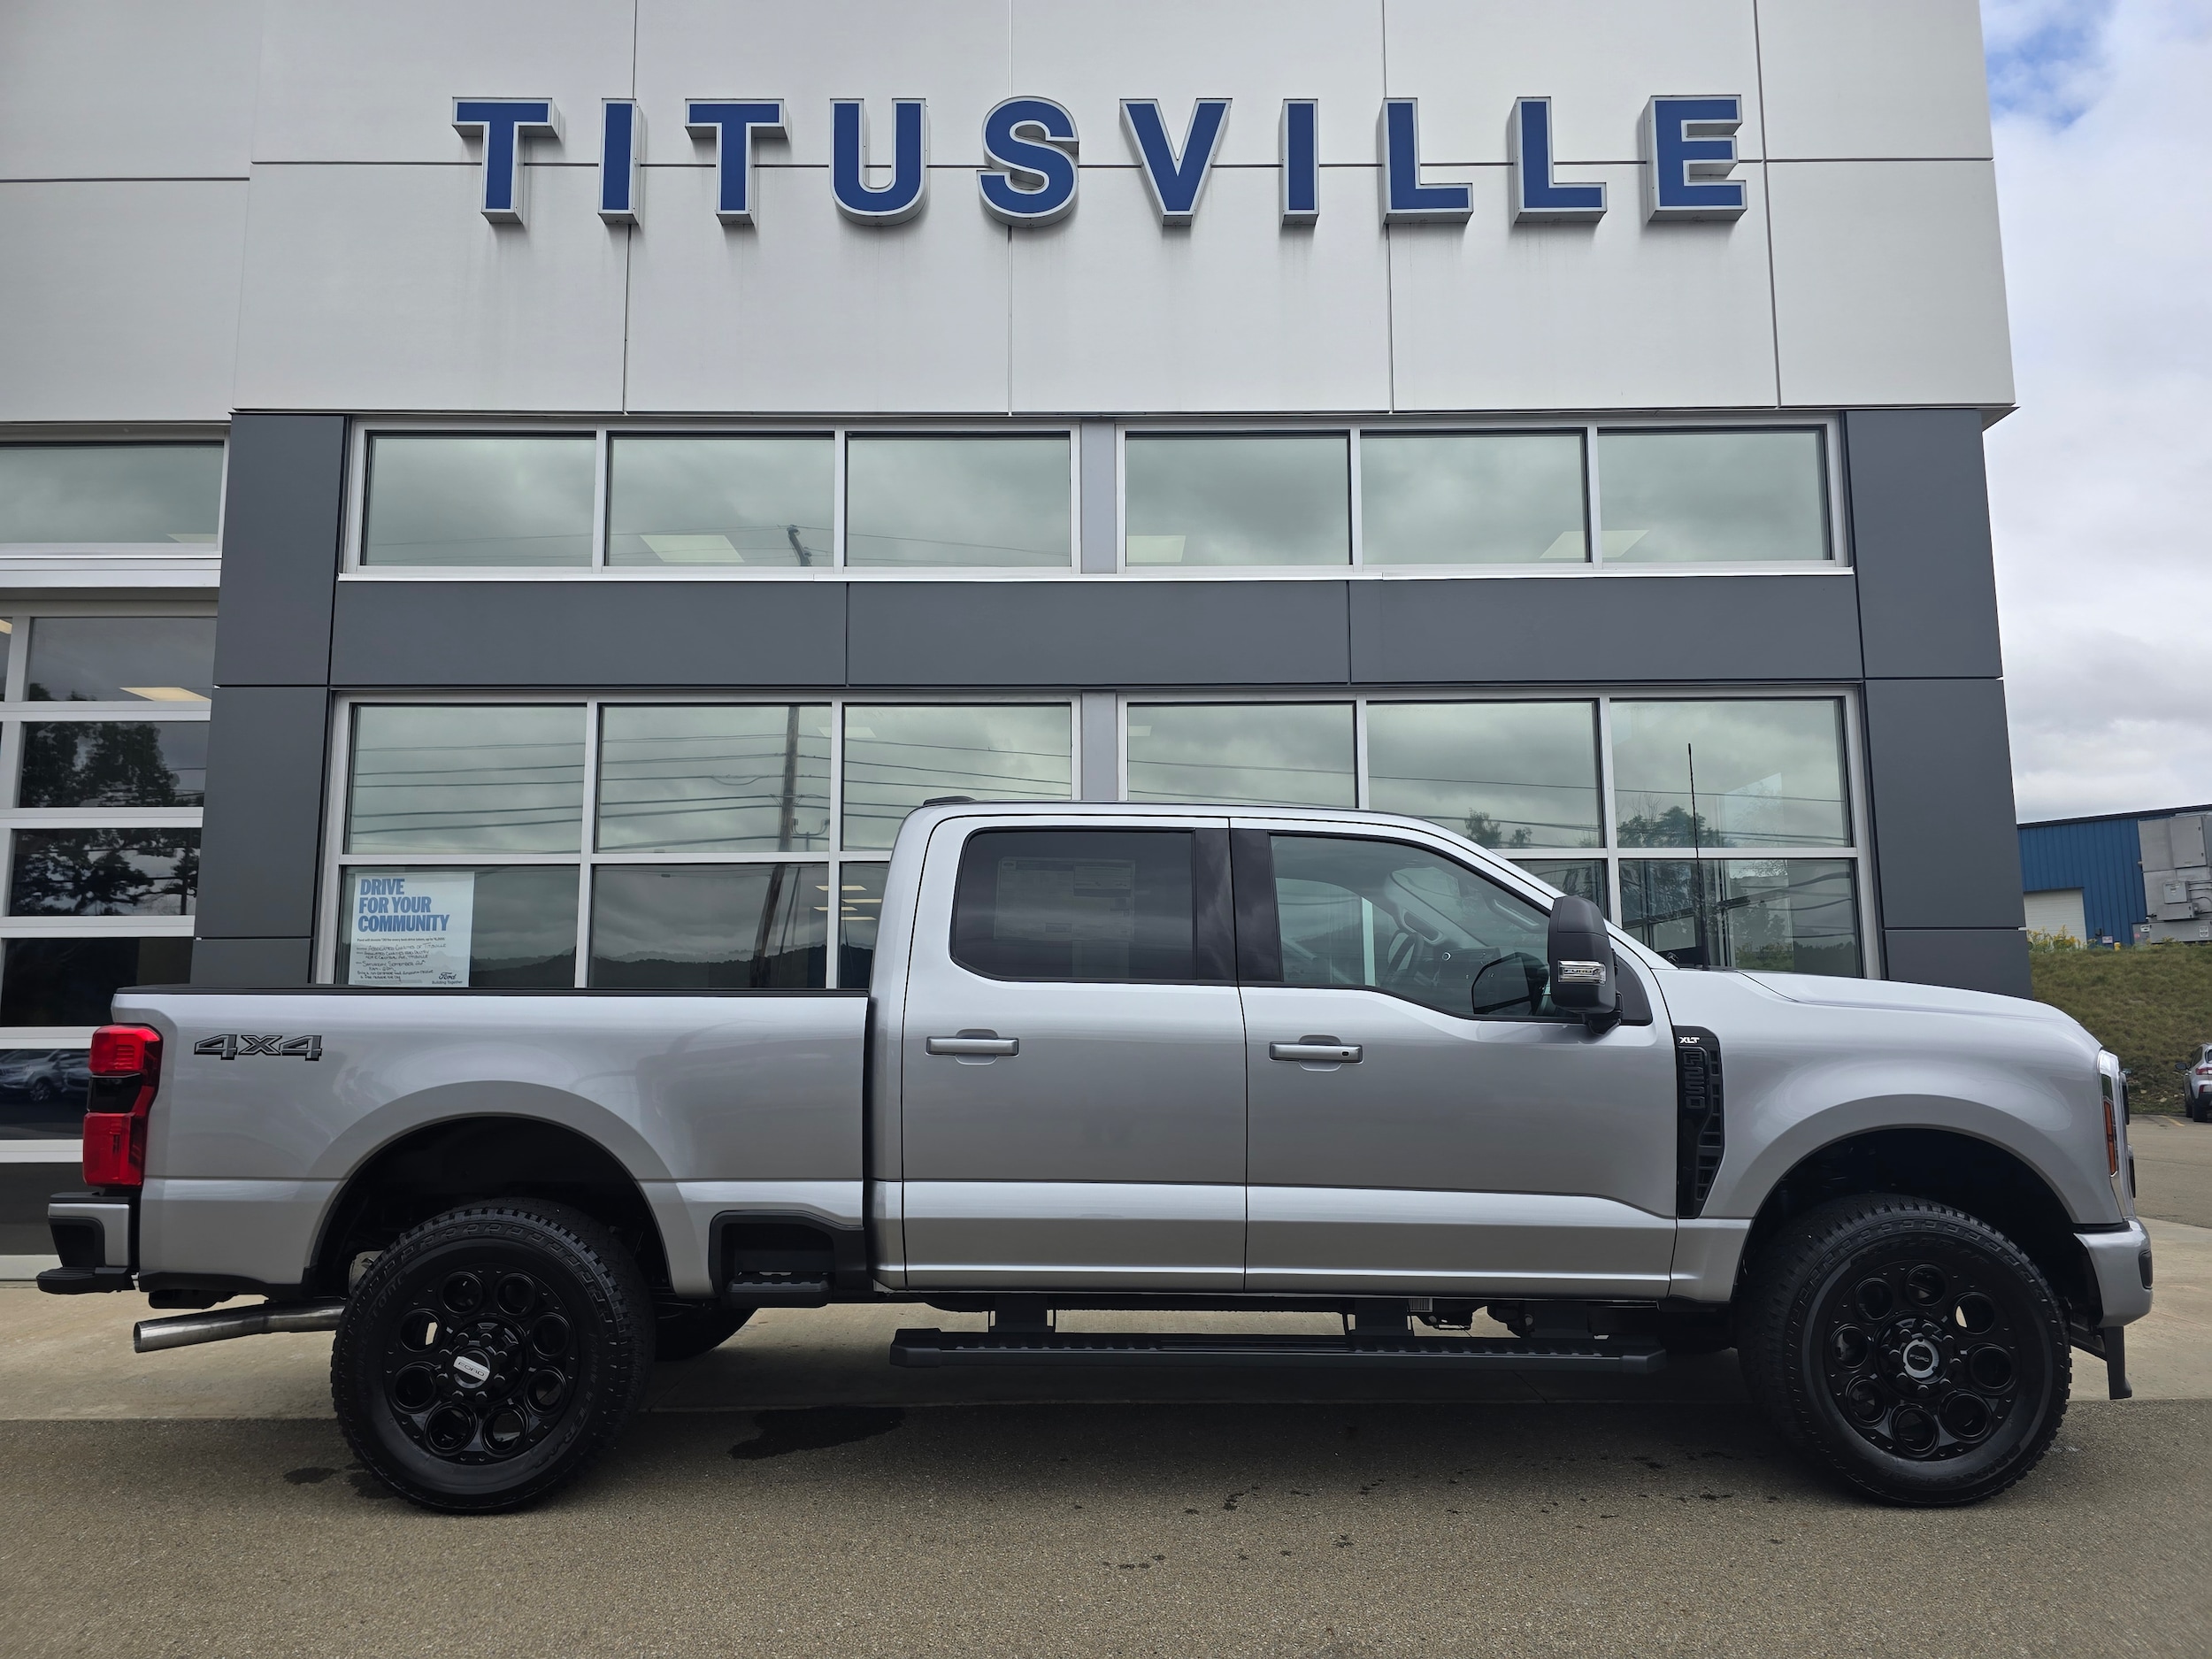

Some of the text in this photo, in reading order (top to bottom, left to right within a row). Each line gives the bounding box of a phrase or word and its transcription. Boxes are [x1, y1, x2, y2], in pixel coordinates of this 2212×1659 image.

[452, 95, 1747, 227] TITUSVILLE
[360, 878, 405, 895] DRIVE
[358, 896, 432, 914] FOR YOUR
[357, 914, 450, 933] COMMUNITY
[438, 972, 457, 980] Ford
[457, 1361, 486, 1378] FORD
